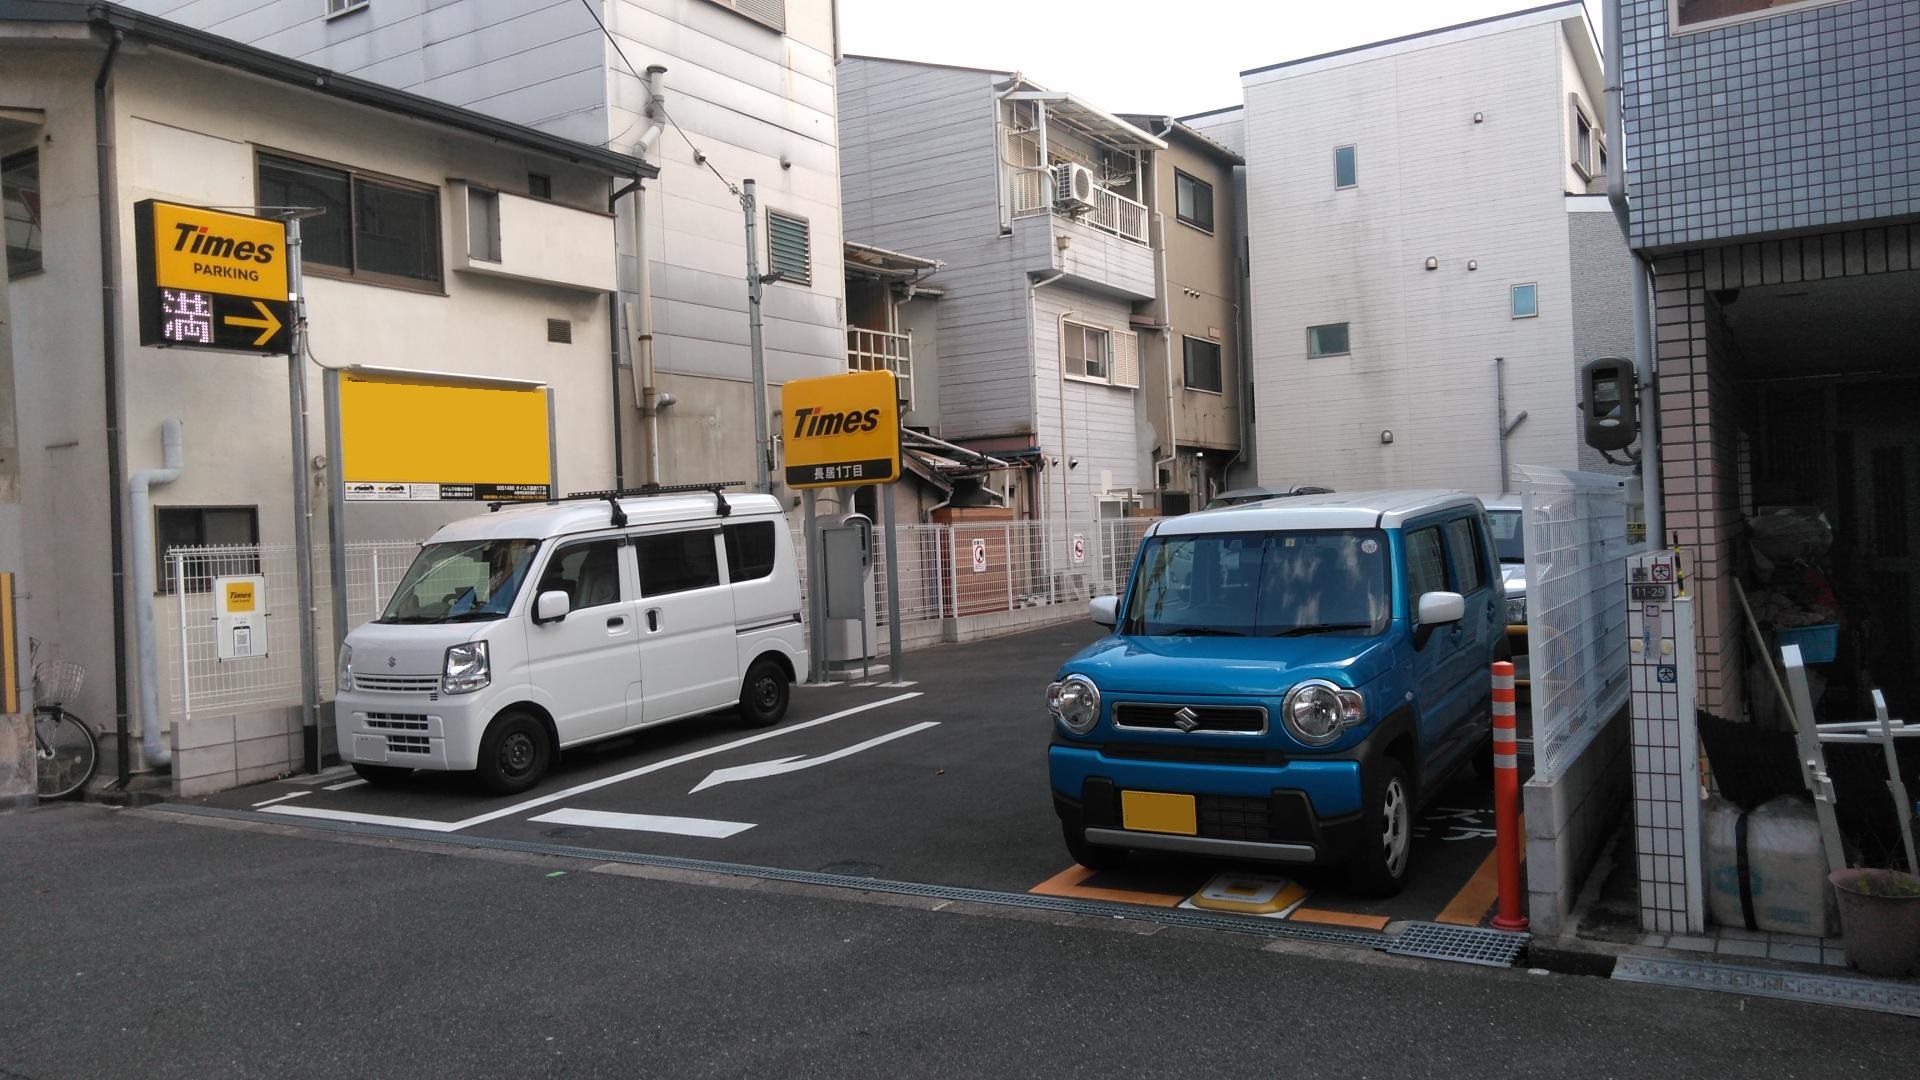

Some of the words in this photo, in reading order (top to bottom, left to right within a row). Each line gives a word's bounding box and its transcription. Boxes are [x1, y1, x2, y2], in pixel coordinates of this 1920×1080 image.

[174, 223, 274, 263] Times
[194, 263, 259, 281] PARKING
[163, 290, 211, 343] 満
[794, 407, 880, 438] Times
[814, 464, 863, 481] 長居1丁目
[230, 591, 252, 599] Times
[1635, 587, 1665, 597] 11-29
